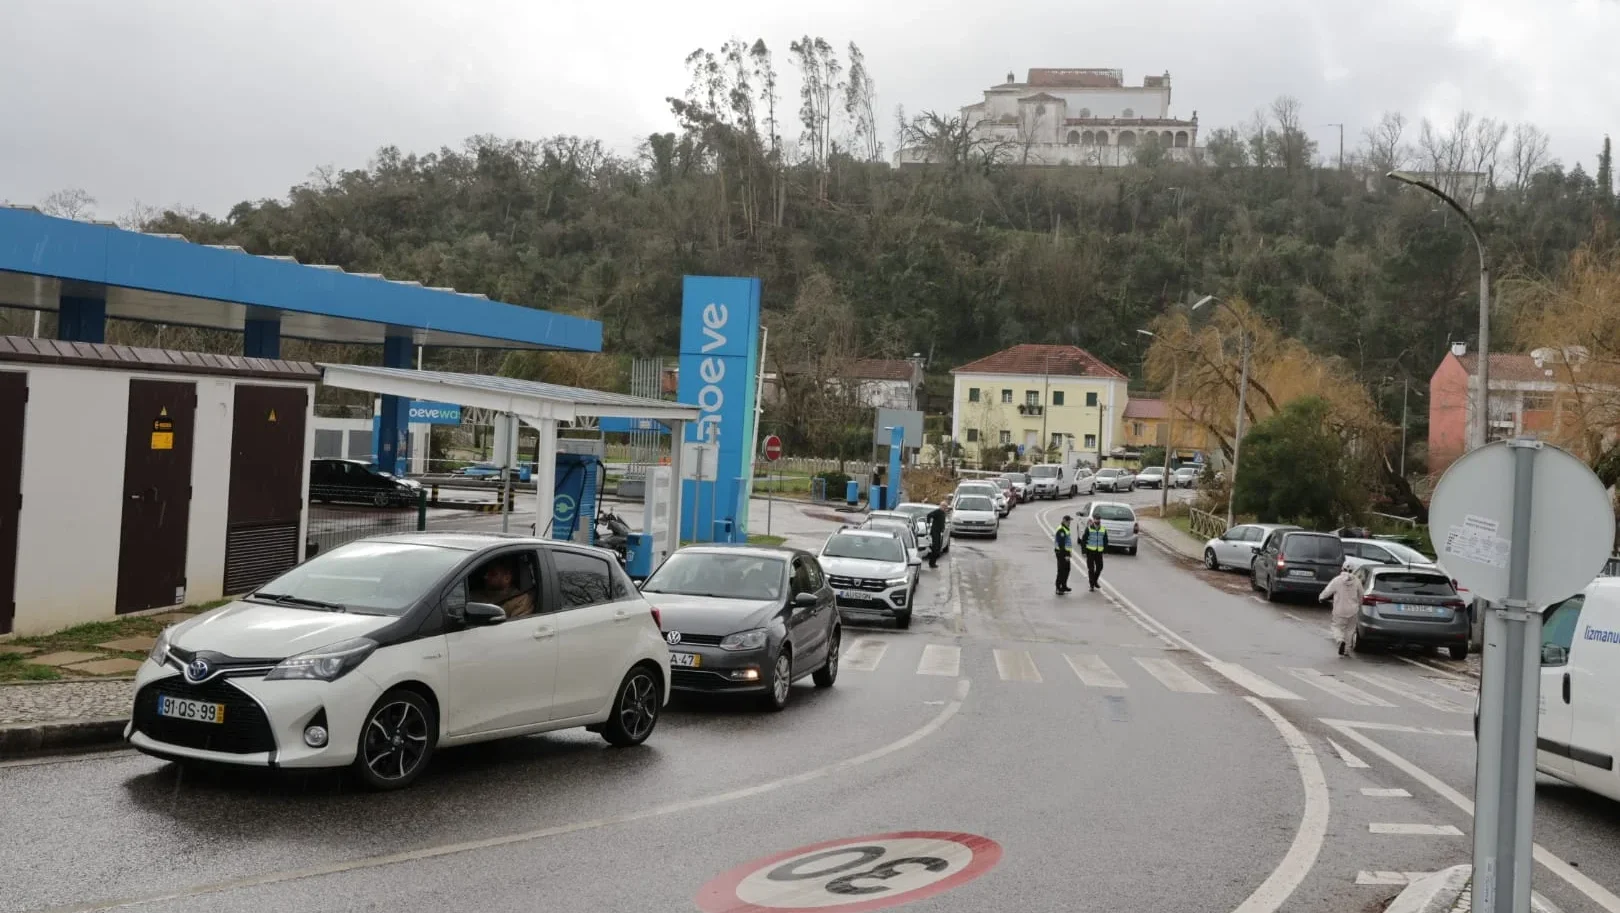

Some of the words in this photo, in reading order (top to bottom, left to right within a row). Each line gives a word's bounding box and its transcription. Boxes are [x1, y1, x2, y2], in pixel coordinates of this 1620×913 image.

[408, 407, 460, 420] oevewa
[1584, 625, 1620, 643] lizmanu
[670, 653, 694, 666] A-47
[164, 698, 216, 721] 91-QS-99
[767, 846, 949, 896] 30
